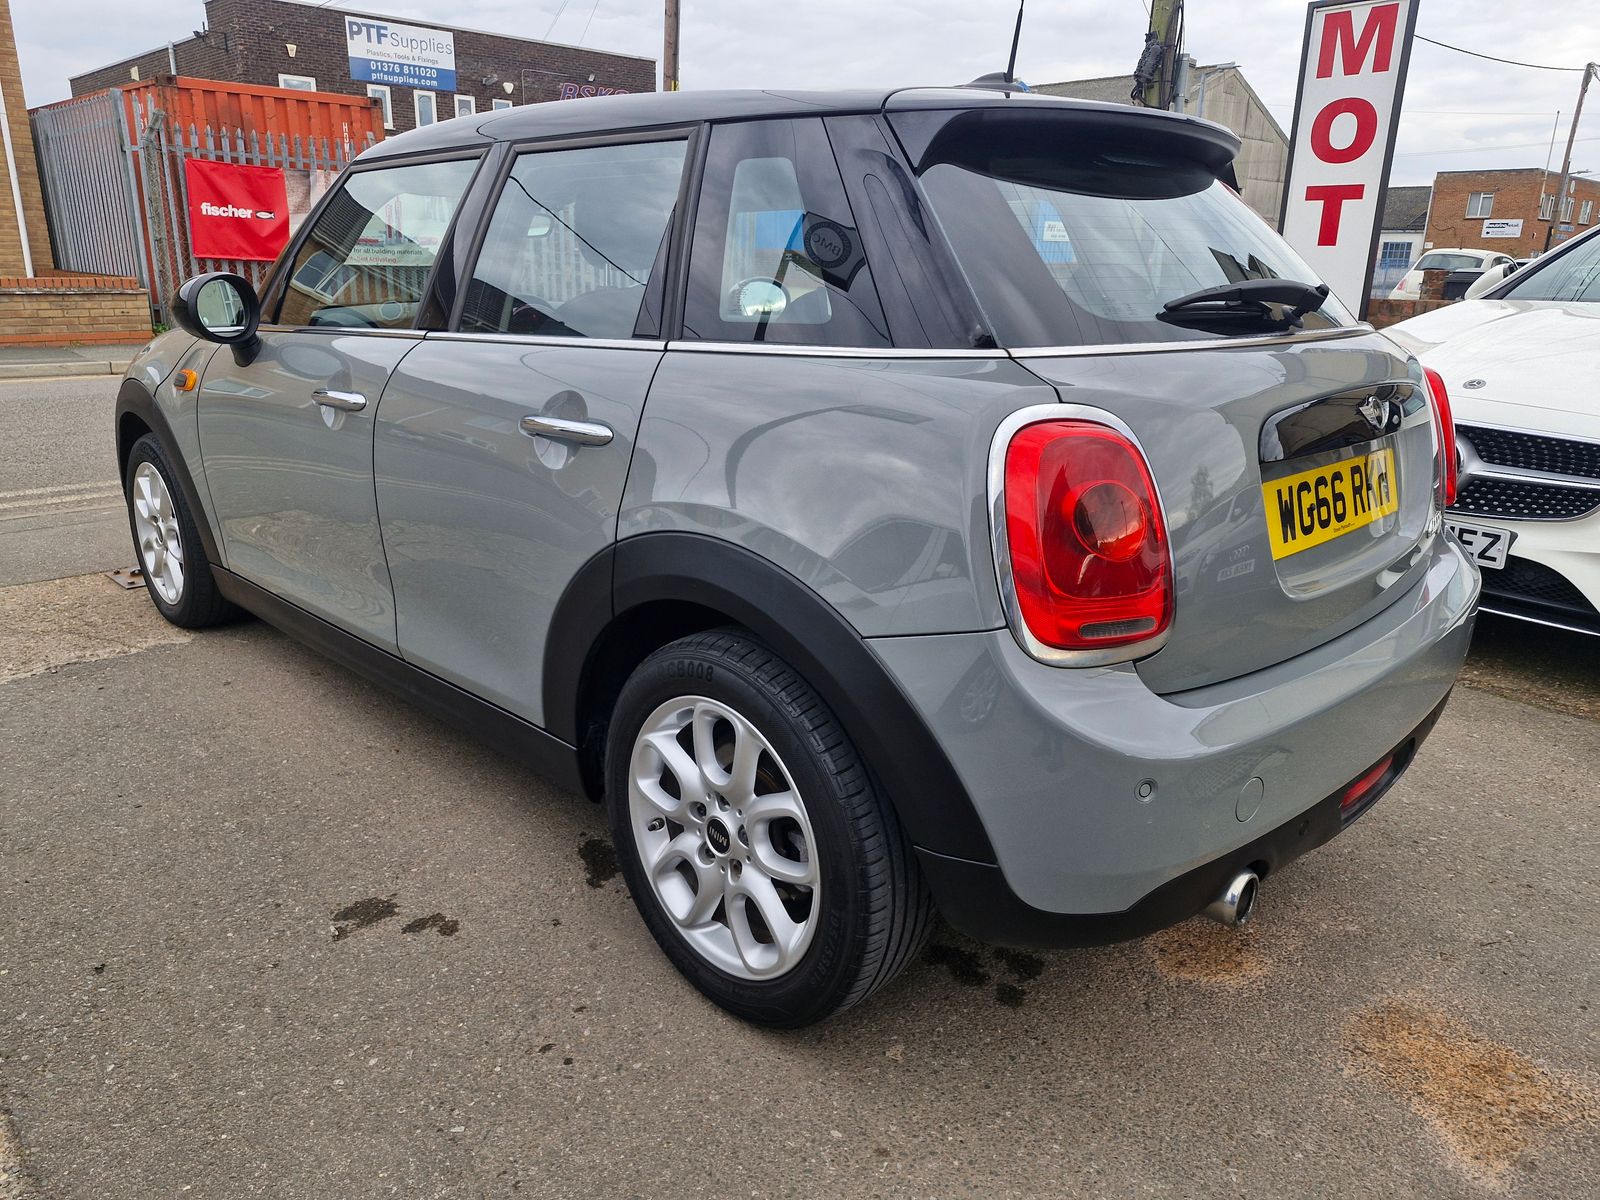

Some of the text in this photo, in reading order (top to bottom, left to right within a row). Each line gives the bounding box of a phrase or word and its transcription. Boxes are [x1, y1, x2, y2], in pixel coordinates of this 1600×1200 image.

[347, 20, 453, 55] PTF Supplies
[366, 49, 393, 58] Plastics,
[394, 52, 410, 61] Tools
[417, 55, 439, 65] Fixings
[370, 60, 437, 78] 01376 811020
[371, 72, 438, 87] ptfsupplies.com
[1305, 3, 1400, 247] MOT
[200, 201, 253, 219] fischer
[371, 248, 396, 256] building
[1276, 470, 1347, 545] WG66
[1449, 525, 1502, 562] EZ
